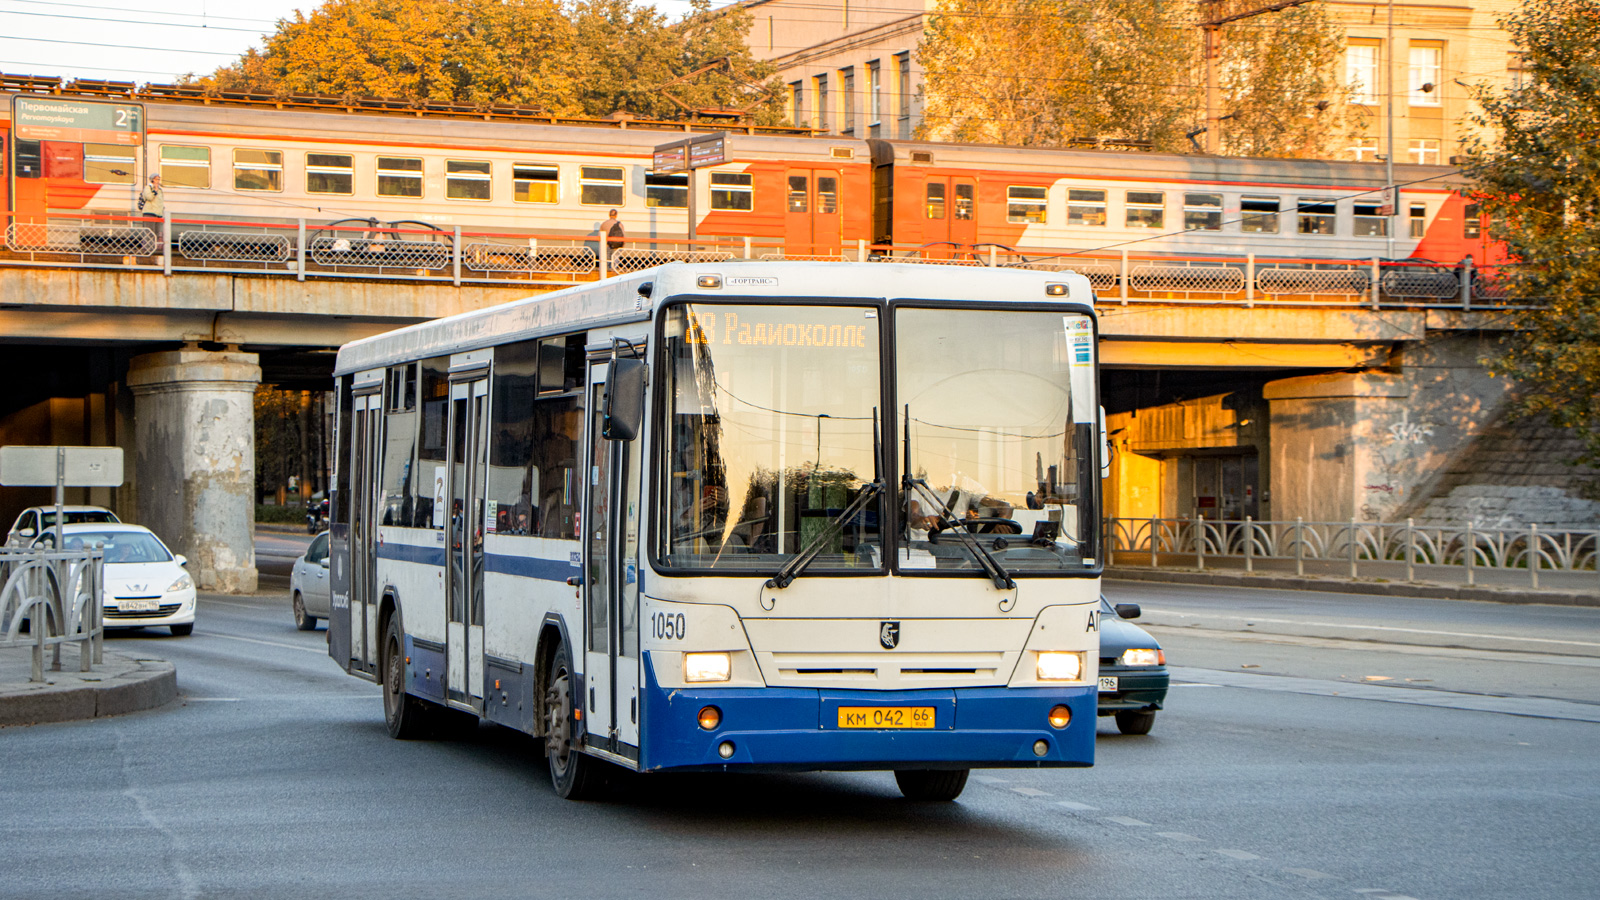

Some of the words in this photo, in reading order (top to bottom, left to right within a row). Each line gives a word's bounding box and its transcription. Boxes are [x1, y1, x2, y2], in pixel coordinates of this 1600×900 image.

[21, 101, 89, 114] Первомайская
[116, 109, 127, 126] 2
[686, 312, 716, 344] 28
[723, 312, 866, 348] Радиоколле
[651, 611, 686, 640] 1050
[1099, 678, 1115, 687] 196
[846, 713, 867, 726] КМ
[873, 710, 903, 725] 042
[913, 709, 929, 721] 66
